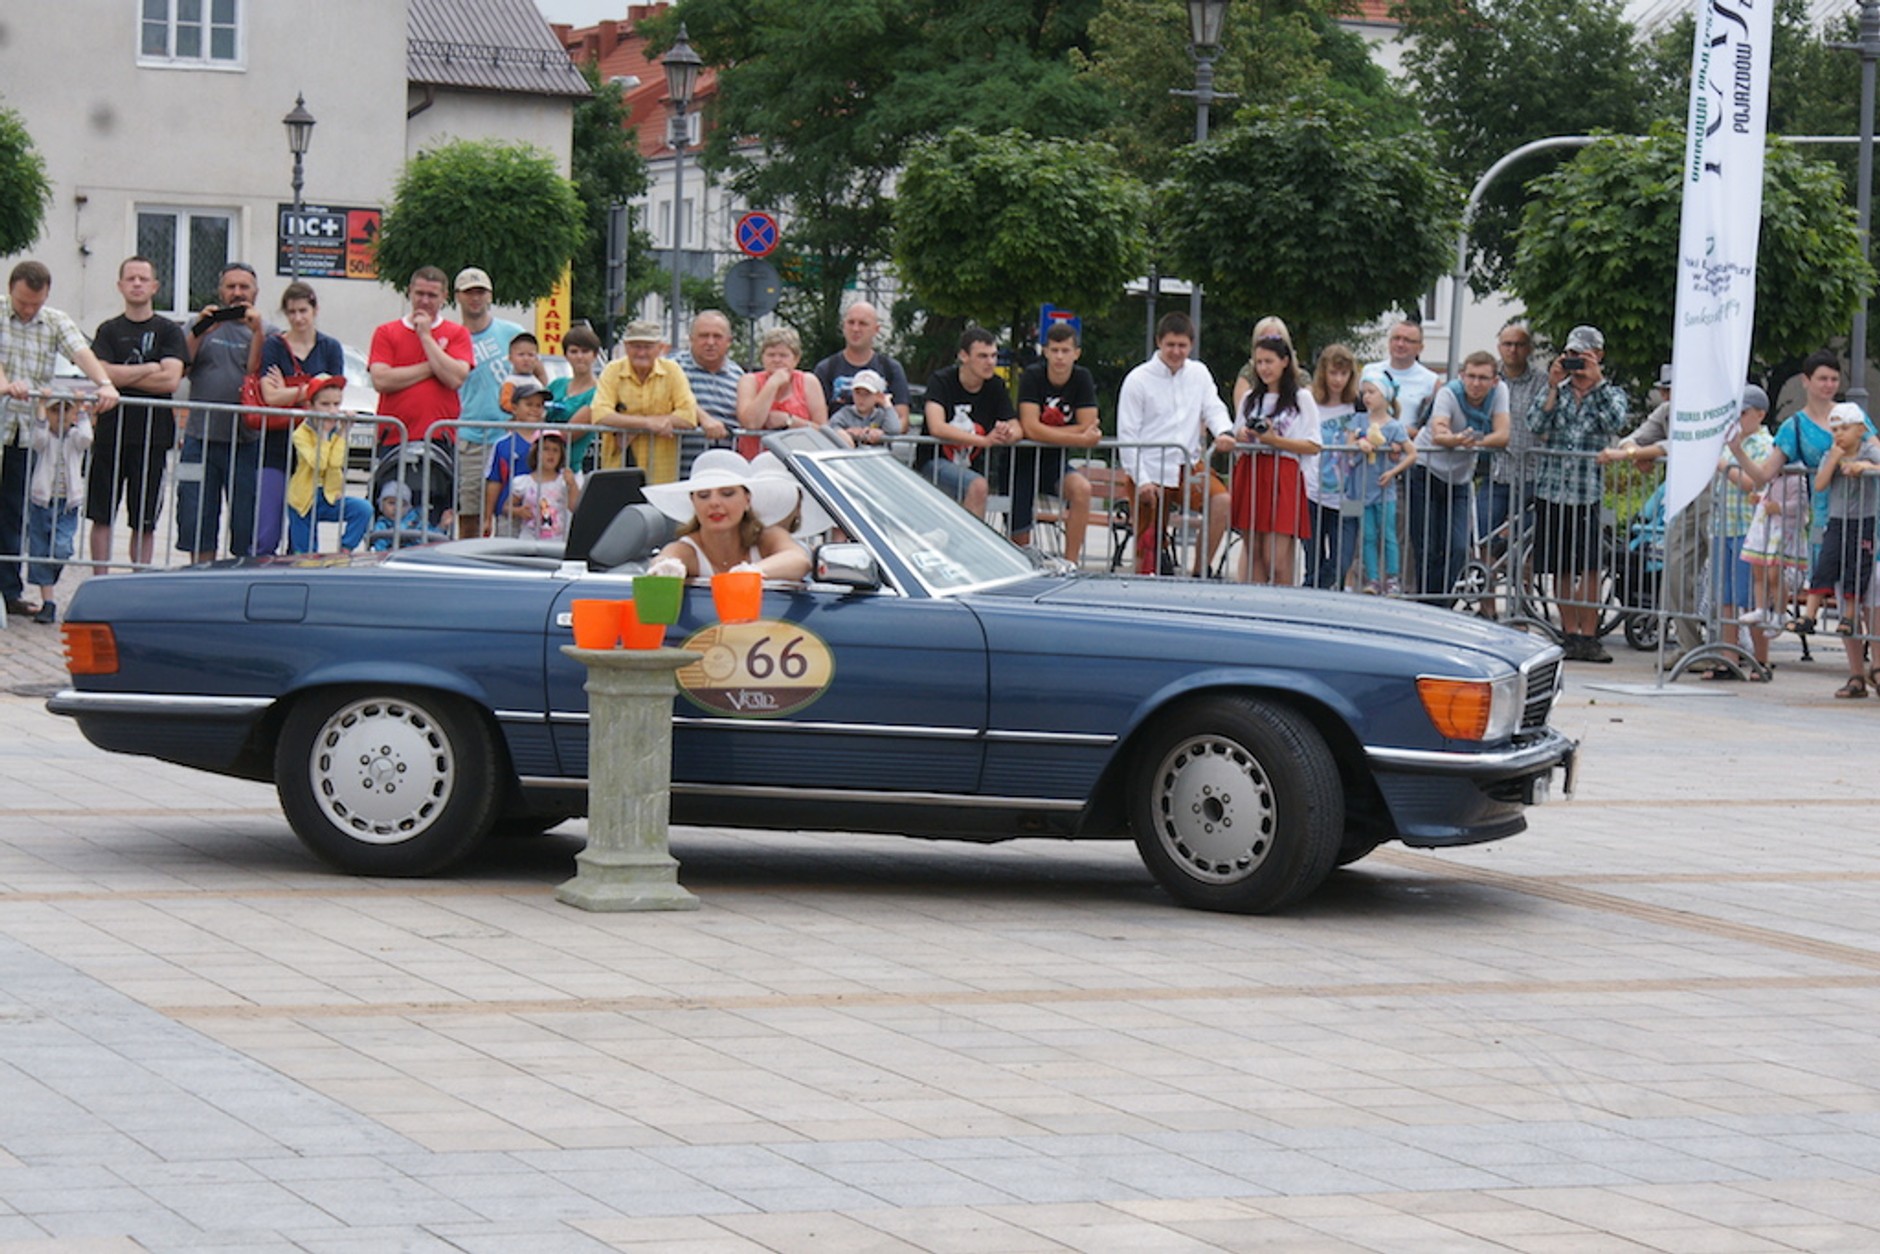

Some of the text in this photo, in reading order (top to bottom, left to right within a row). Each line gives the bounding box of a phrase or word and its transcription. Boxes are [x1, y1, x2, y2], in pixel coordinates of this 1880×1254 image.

[1732, 42, 1753, 134] POJAZDÓW
[288, 216, 339, 236] nc+
[746, 635, 808, 679] 66
